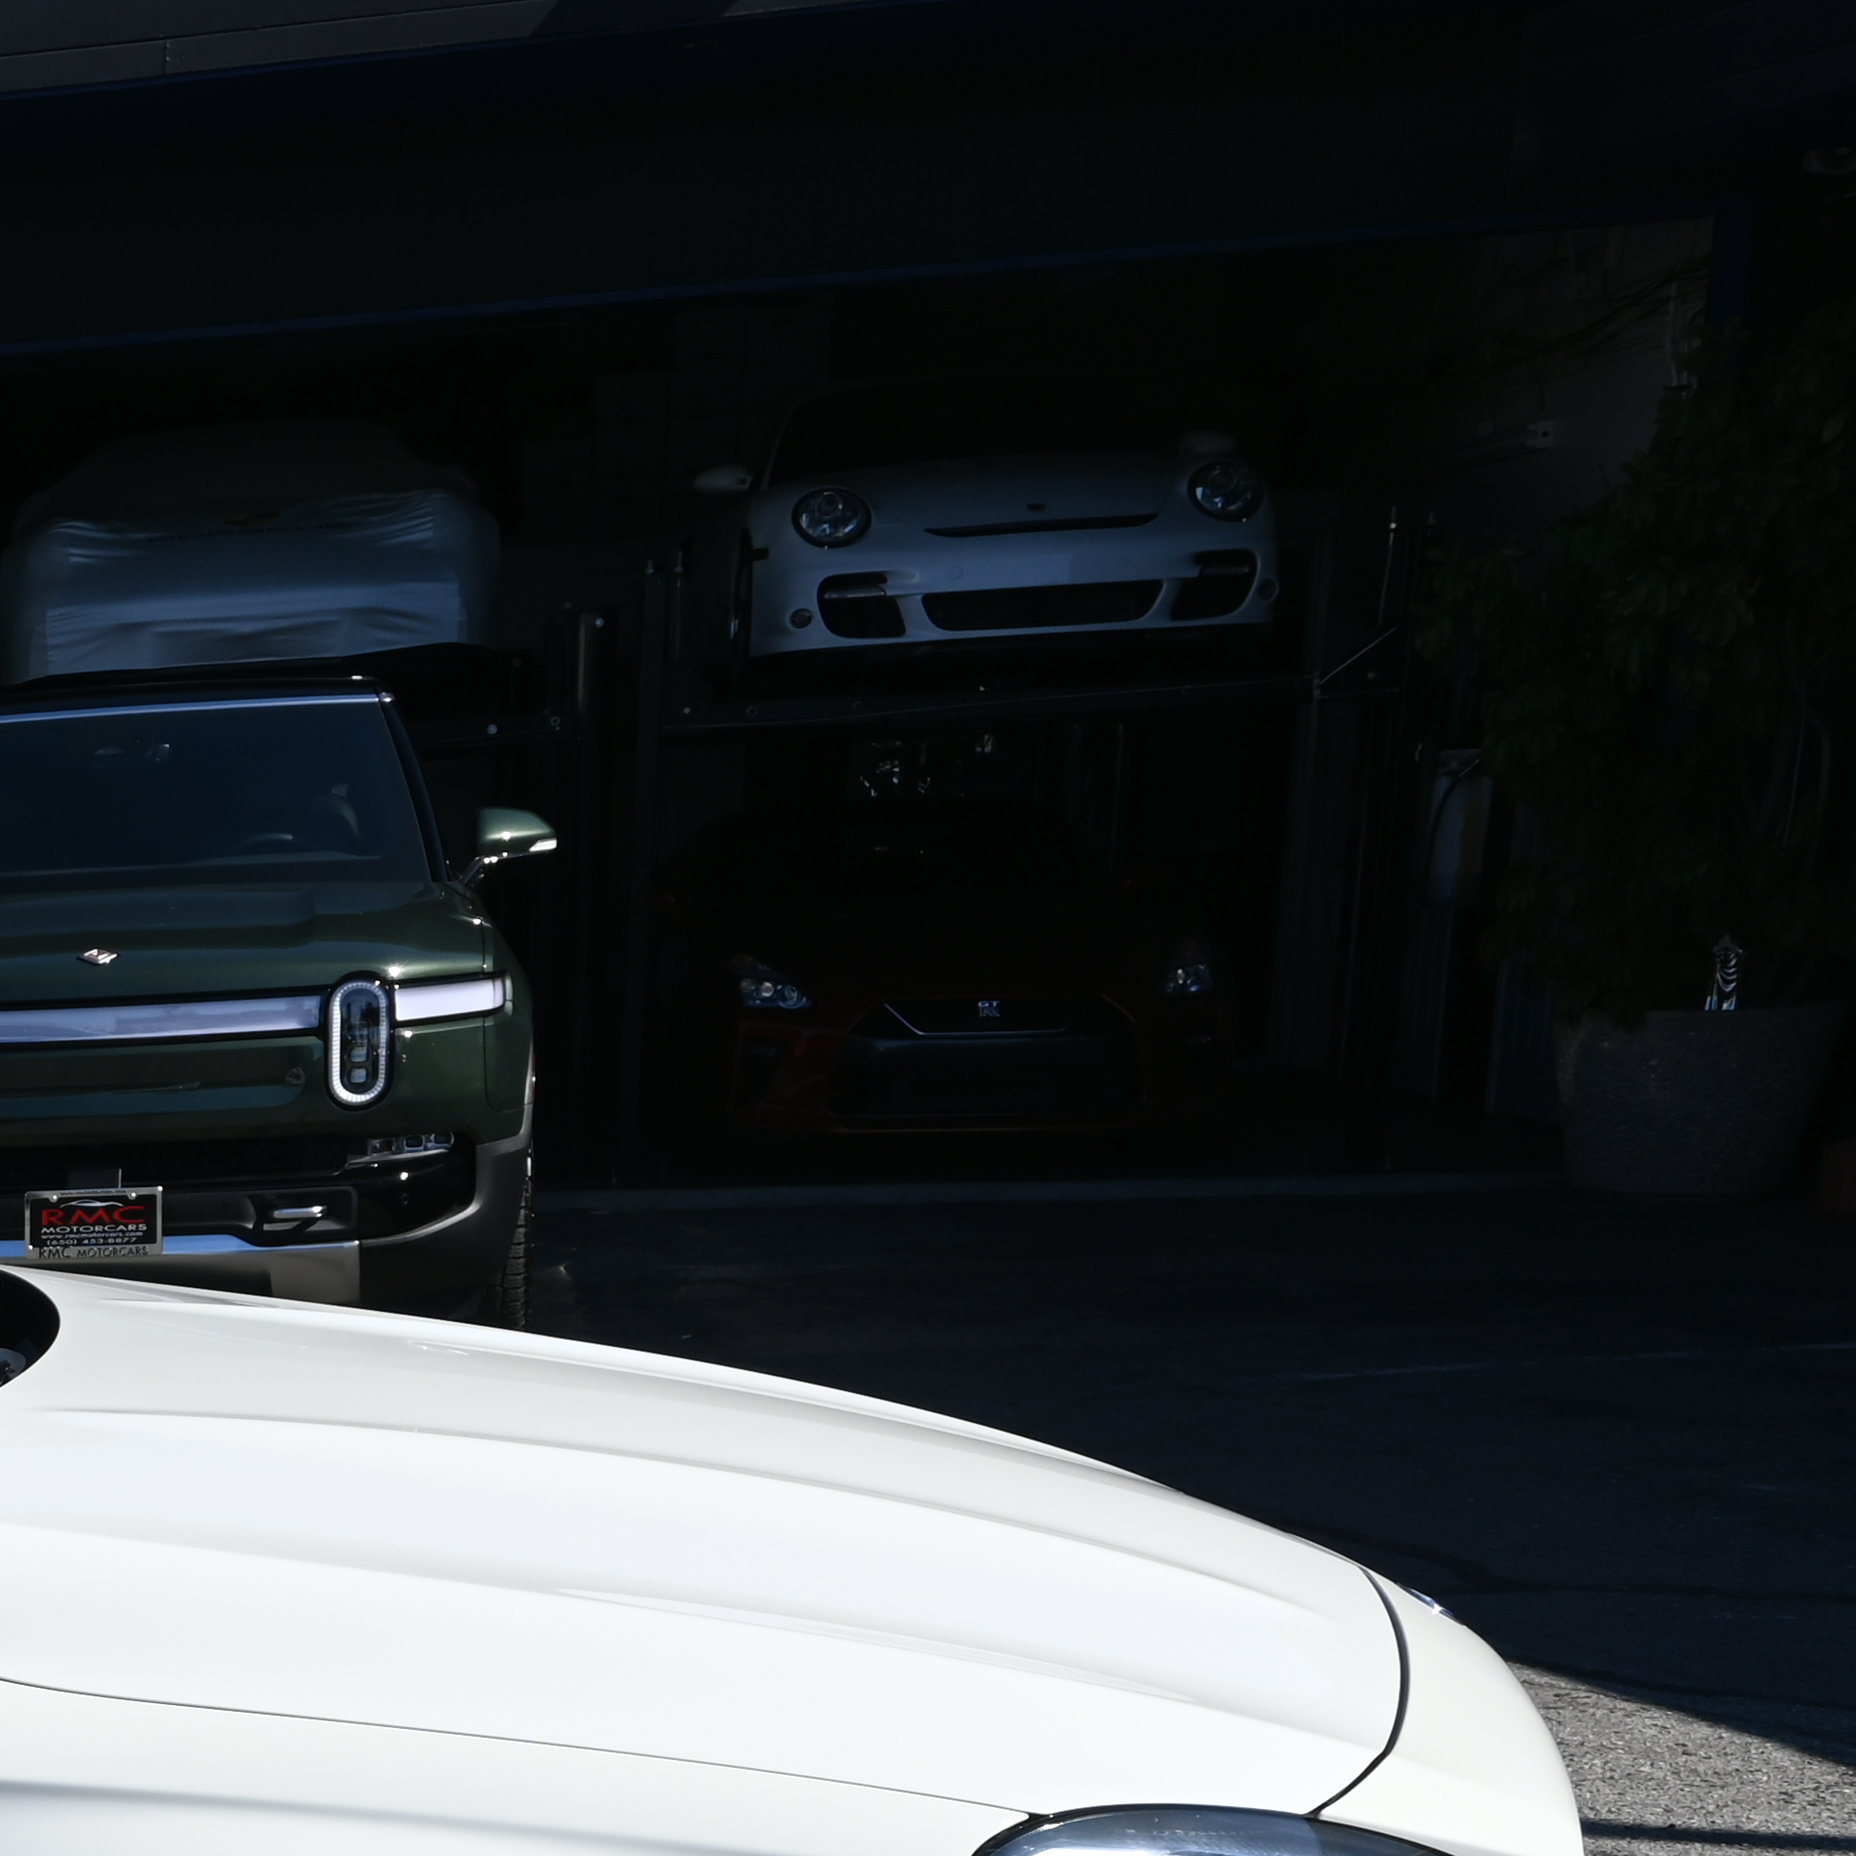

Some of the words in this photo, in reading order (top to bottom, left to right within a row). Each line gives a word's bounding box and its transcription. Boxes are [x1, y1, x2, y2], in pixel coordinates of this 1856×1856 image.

[40, 1205, 147, 1226] RMC
[40, 1223, 148, 1234] MOTORCARS
[77, 1245, 149, 1258] MOTORCARS
